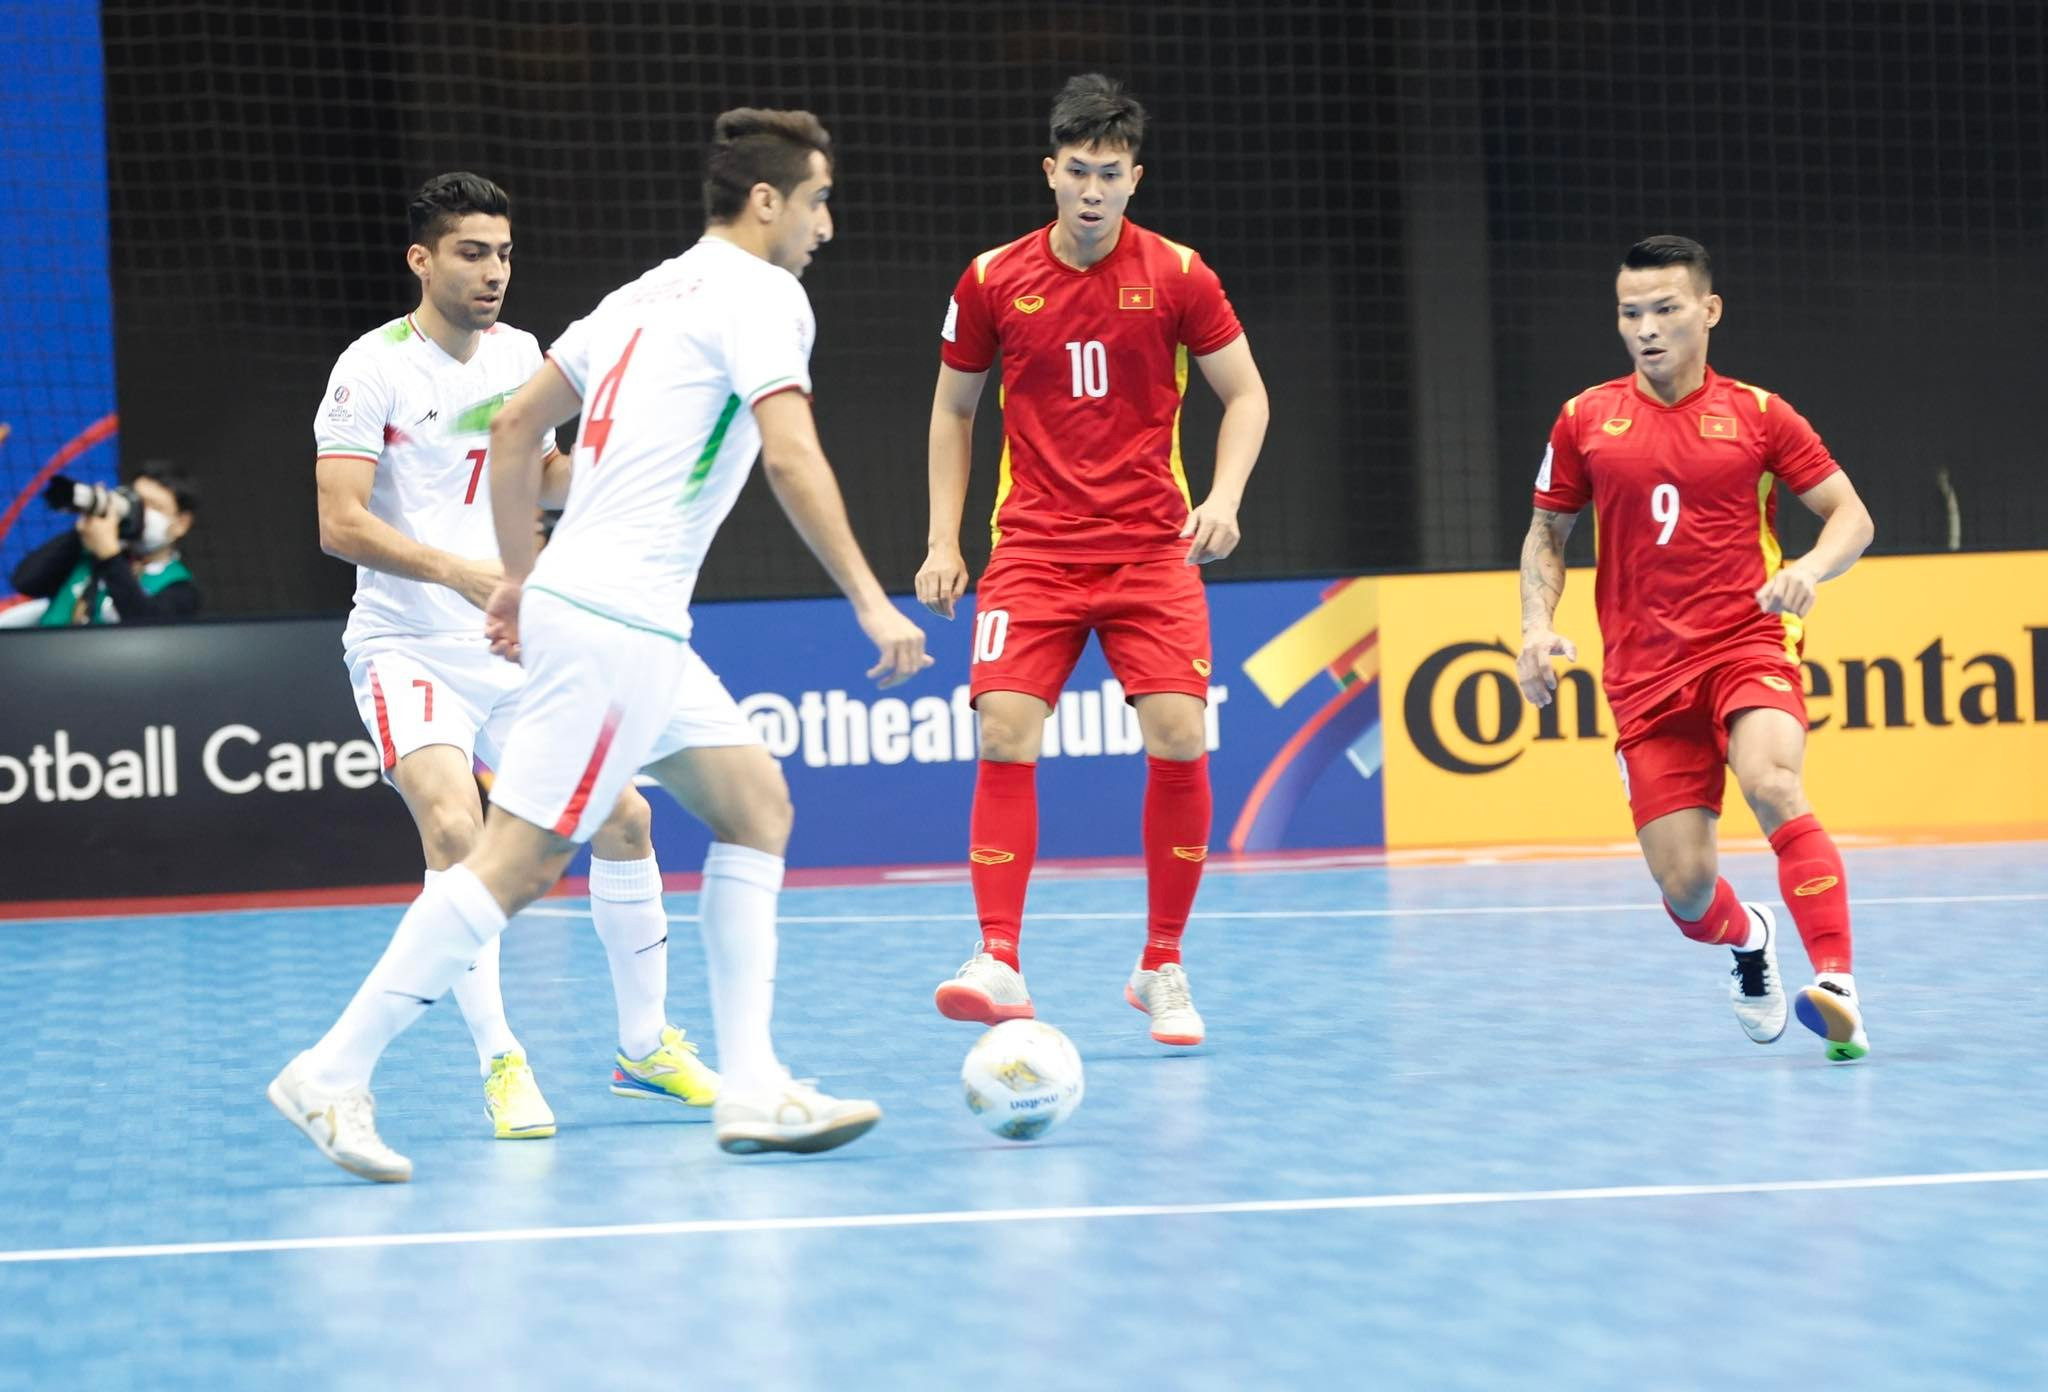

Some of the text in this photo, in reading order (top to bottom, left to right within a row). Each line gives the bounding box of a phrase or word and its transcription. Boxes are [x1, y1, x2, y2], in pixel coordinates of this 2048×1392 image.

[582, 327, 643, 464] 4
[1065, 340, 1108, 398] 10
[464, 449, 487, 505] 7
[1651, 483, 1680, 545] 9
[972, 610, 1008, 664] 10
[412, 679, 433, 722] 7
[1404, 626, 2048, 775] Conental
[202, 724, 394, 794] Care
